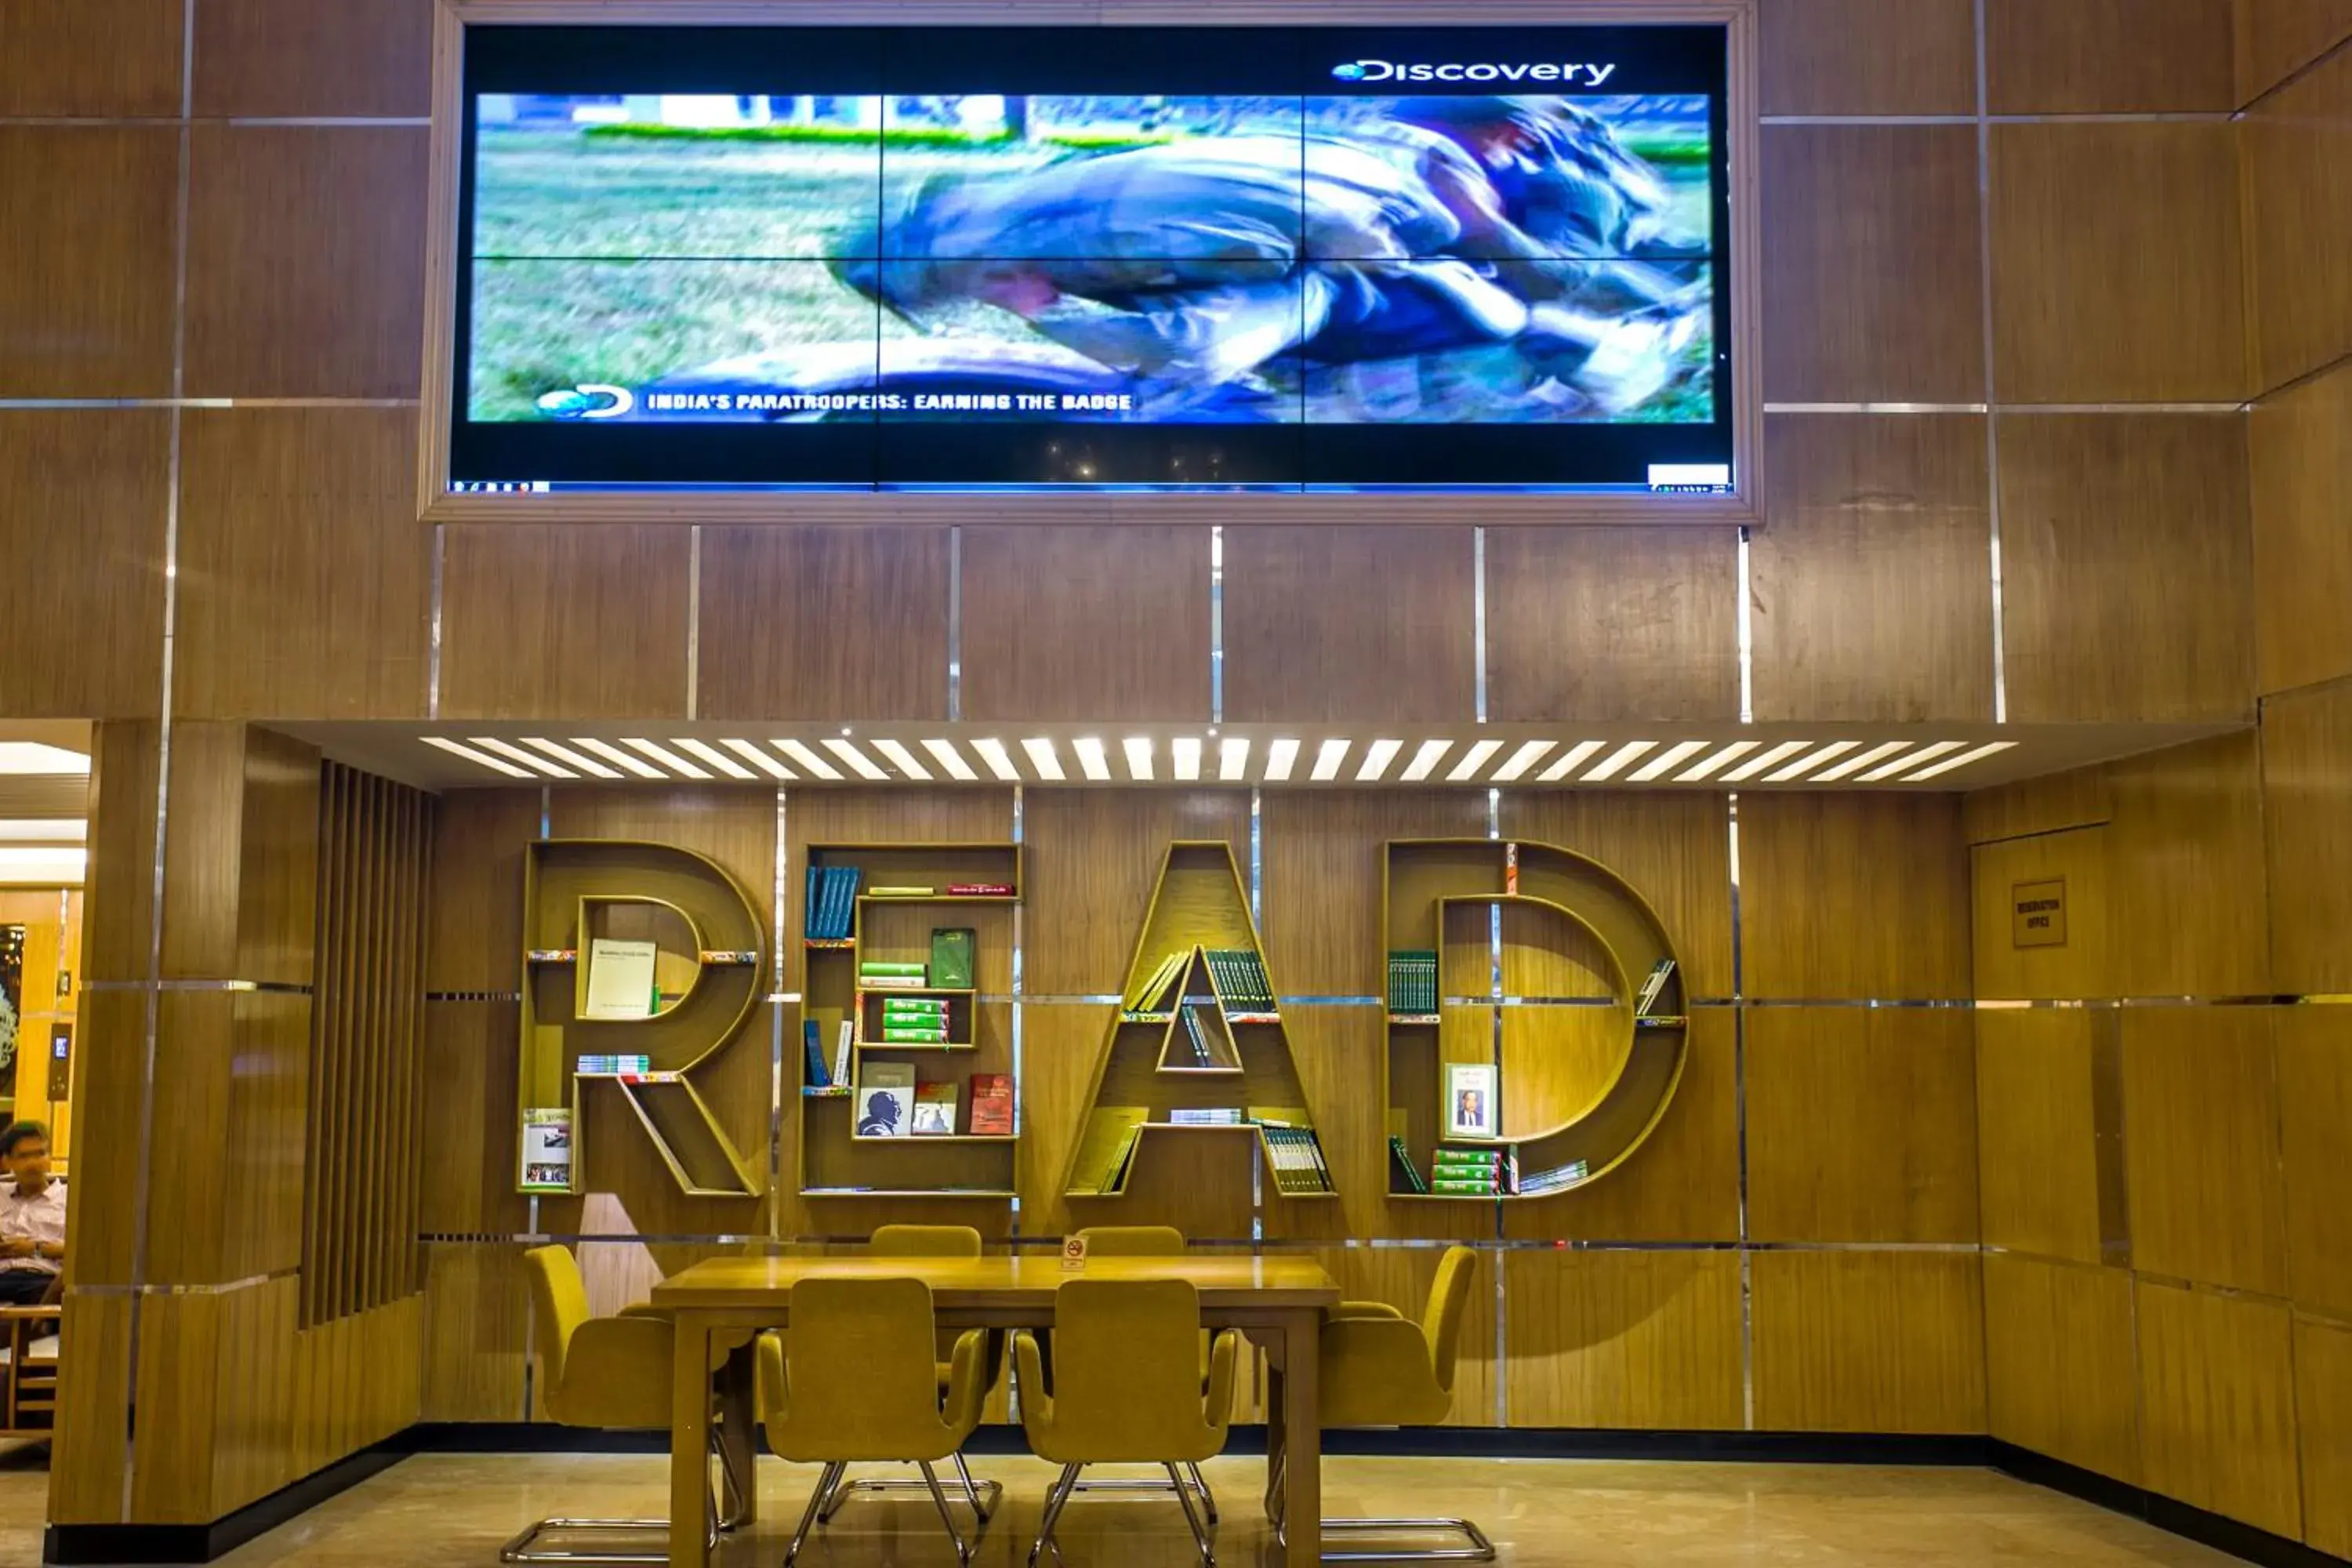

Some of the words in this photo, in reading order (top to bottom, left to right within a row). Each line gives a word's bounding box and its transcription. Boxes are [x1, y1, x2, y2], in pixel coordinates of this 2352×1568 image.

[1356, 59, 1616, 86] Discovery
[648, 394, 730, 410] INDIA'S
[736, 394, 907, 410] PARATROOPERS:
[913, 394, 1011, 410] EARNING
[1018, 394, 1056, 410] THE
[1062, 394, 1131, 410] BADGE
[516, 837, 1690, 1198] READ
